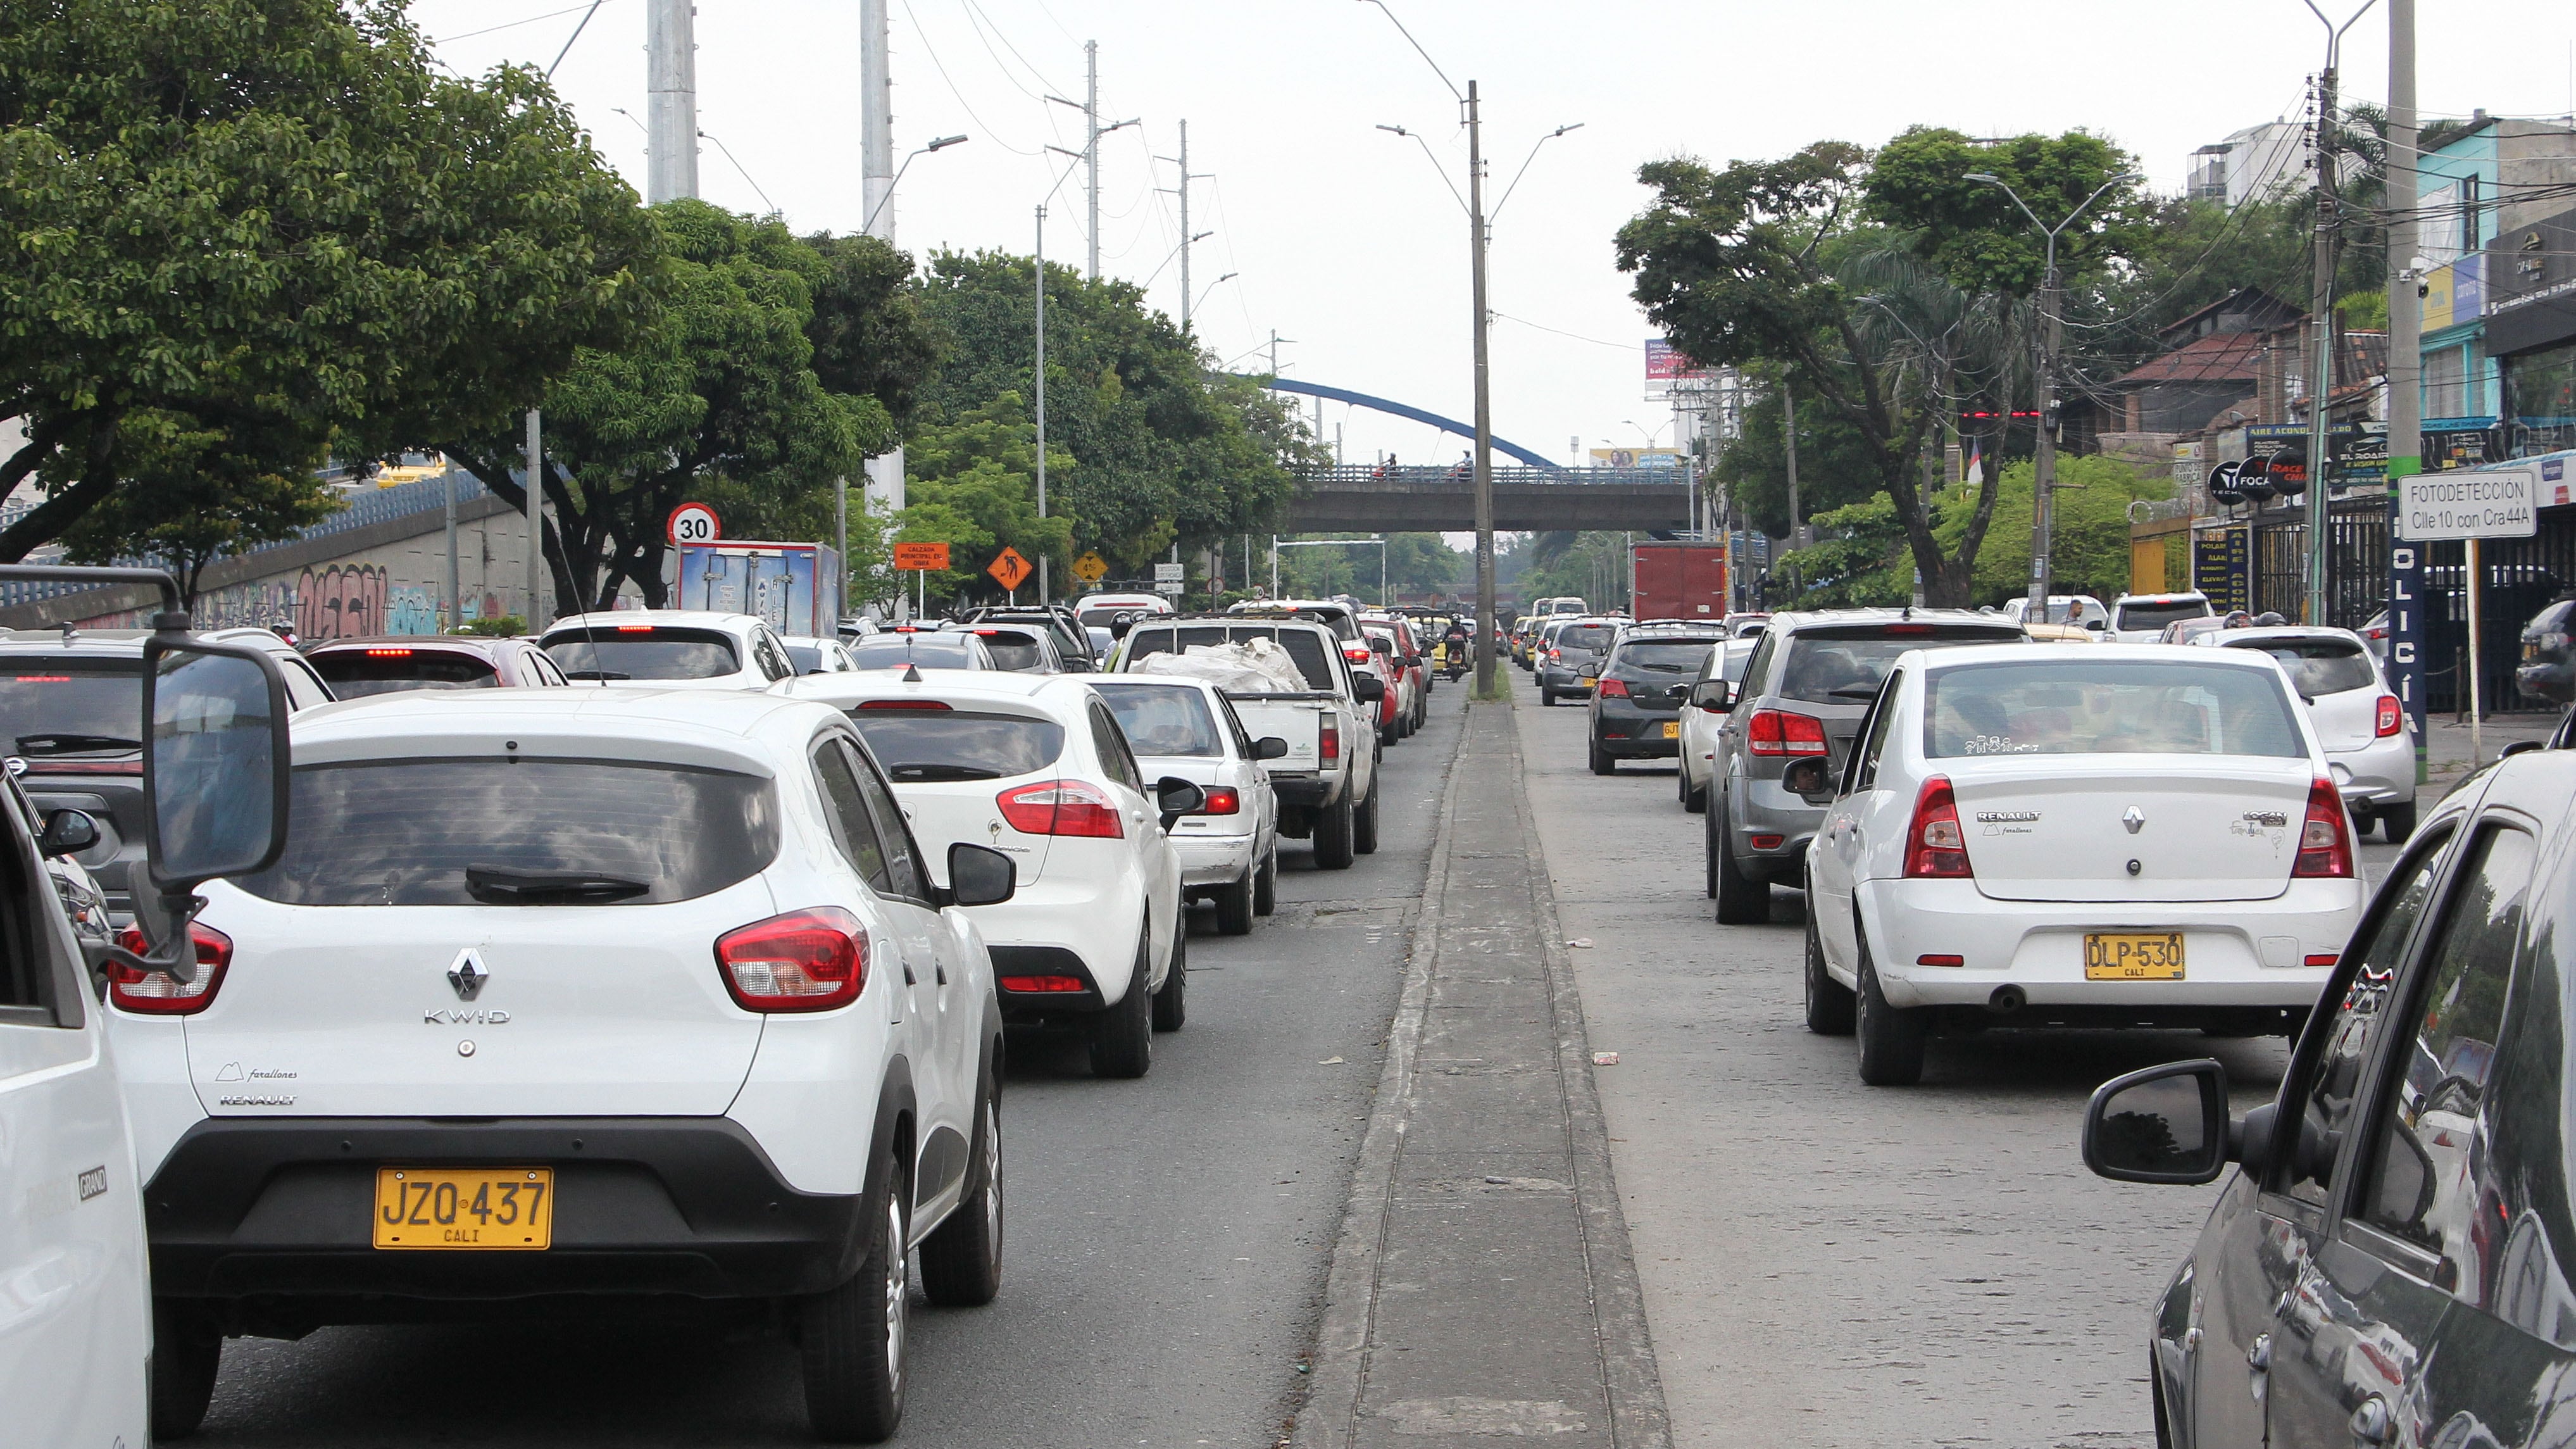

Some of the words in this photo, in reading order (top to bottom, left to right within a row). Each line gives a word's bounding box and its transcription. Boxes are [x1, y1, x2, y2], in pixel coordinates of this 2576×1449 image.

[2250, 427, 2272, 436] AIRE
[2271, 464, 2304, 473] RACE
[2241, 477, 2270, 485] FOCA
[2411, 479, 2524, 503] FOTODETECCIÓN
[2439, 510, 2453, 528] 10
[2457, 514, 2480, 528] con
[2484, 508, 2505, 526] Cra
[2506, 507, 2530, 524] 44A
[680, 518, 708, 539] 30
[1977, 811, 2041, 822] RENAULT
[424, 1009, 511, 1024] KWID
[247, 1069, 297, 1082] farallones
[220, 1095, 297, 1105] RENAULT
[80, 1170, 106, 1198] GRAND
[444, 1229, 480, 1243] CALI
